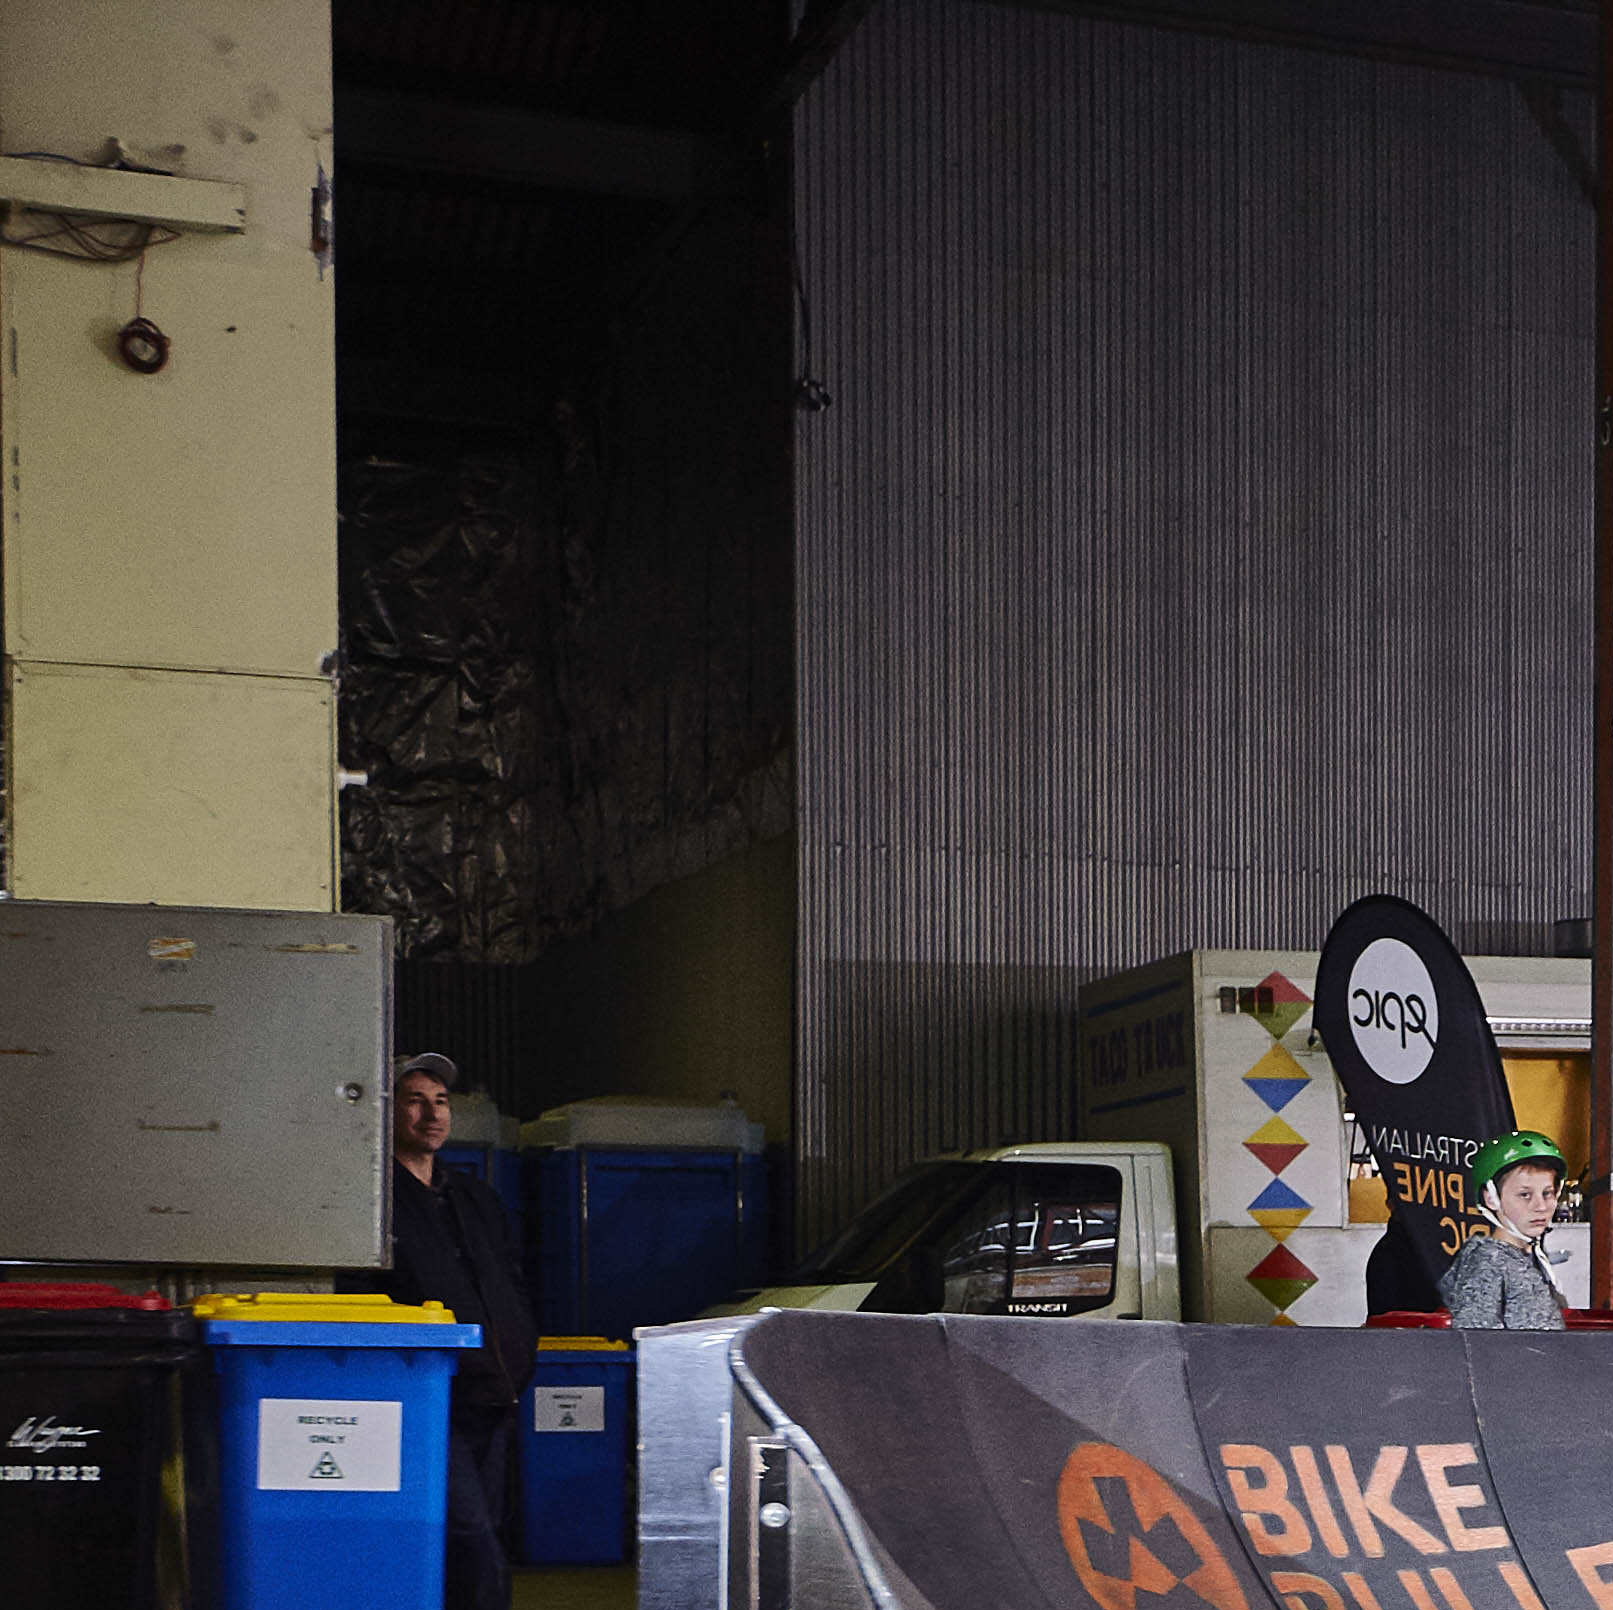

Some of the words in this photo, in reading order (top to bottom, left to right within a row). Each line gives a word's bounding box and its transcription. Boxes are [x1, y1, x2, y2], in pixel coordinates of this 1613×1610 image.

[1008, 1302, 1068, 1313] TRANSIT
[298, 1415, 358, 1426] RECYCLE
[1220, 1442, 1509, 1557] BIKE
